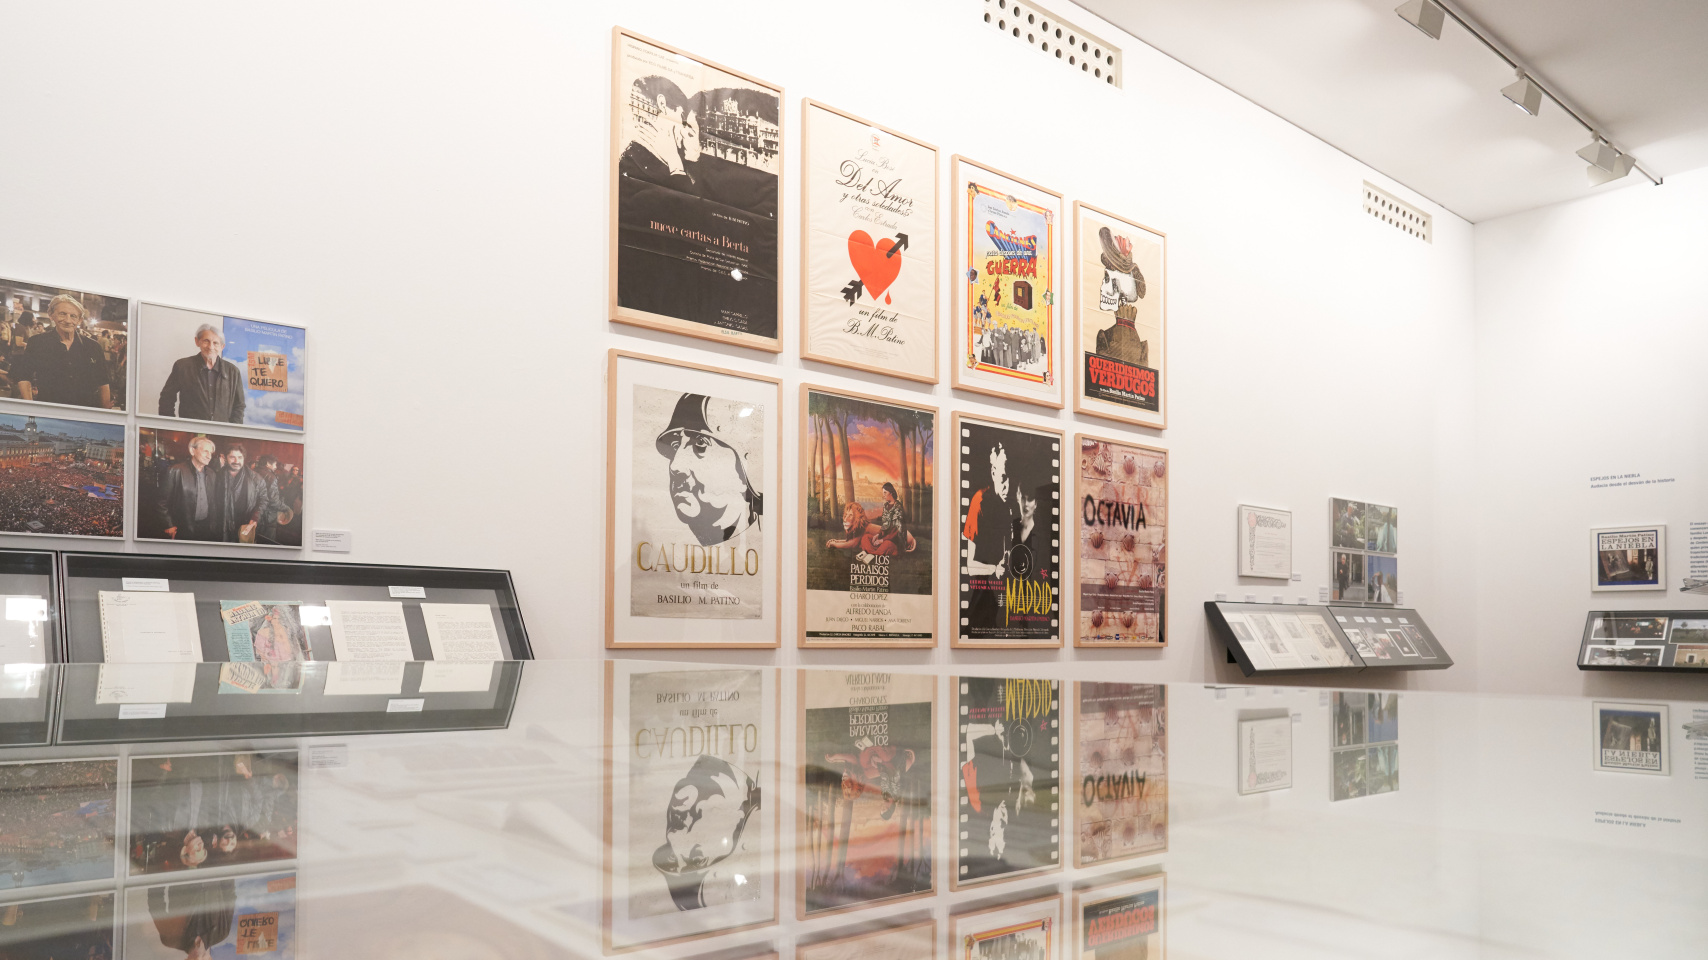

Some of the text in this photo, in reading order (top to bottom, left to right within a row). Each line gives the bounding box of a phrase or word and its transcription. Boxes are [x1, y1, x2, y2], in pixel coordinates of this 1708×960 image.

[836, 160, 913, 207] Del Amor
[839, 192, 848, 203] y
[851, 194, 870, 204] otras
[650, 220, 749, 253] nueve cartas a Berta
[986, 220, 1037, 250] CANCIONES
[986, 256, 1037, 279] GUERRA
[868, 308, 887, 322] film
[889, 313, 899, 323] de
[252, 367, 267, 377] TE
[1089, 356, 1155, 383] QUERIDISIMOS
[250, 377, 284, 388] QUIERO
[1089, 367, 1155, 397] VERDUGOS
[1084, 494, 1146, 531] OCTAVIA
[637, 542, 759, 576] CAUDILLO
[875, 555, 890, 565] LOS
[850, 563, 889, 576] PARAISOS
[693, 581, 708, 590] film
[711, 581, 719, 589] de
[850, 574, 889, 586] PERDIDOS
[657, 595, 692, 604] BASILIO
[1006, 574, 1052, 627] MADRID
